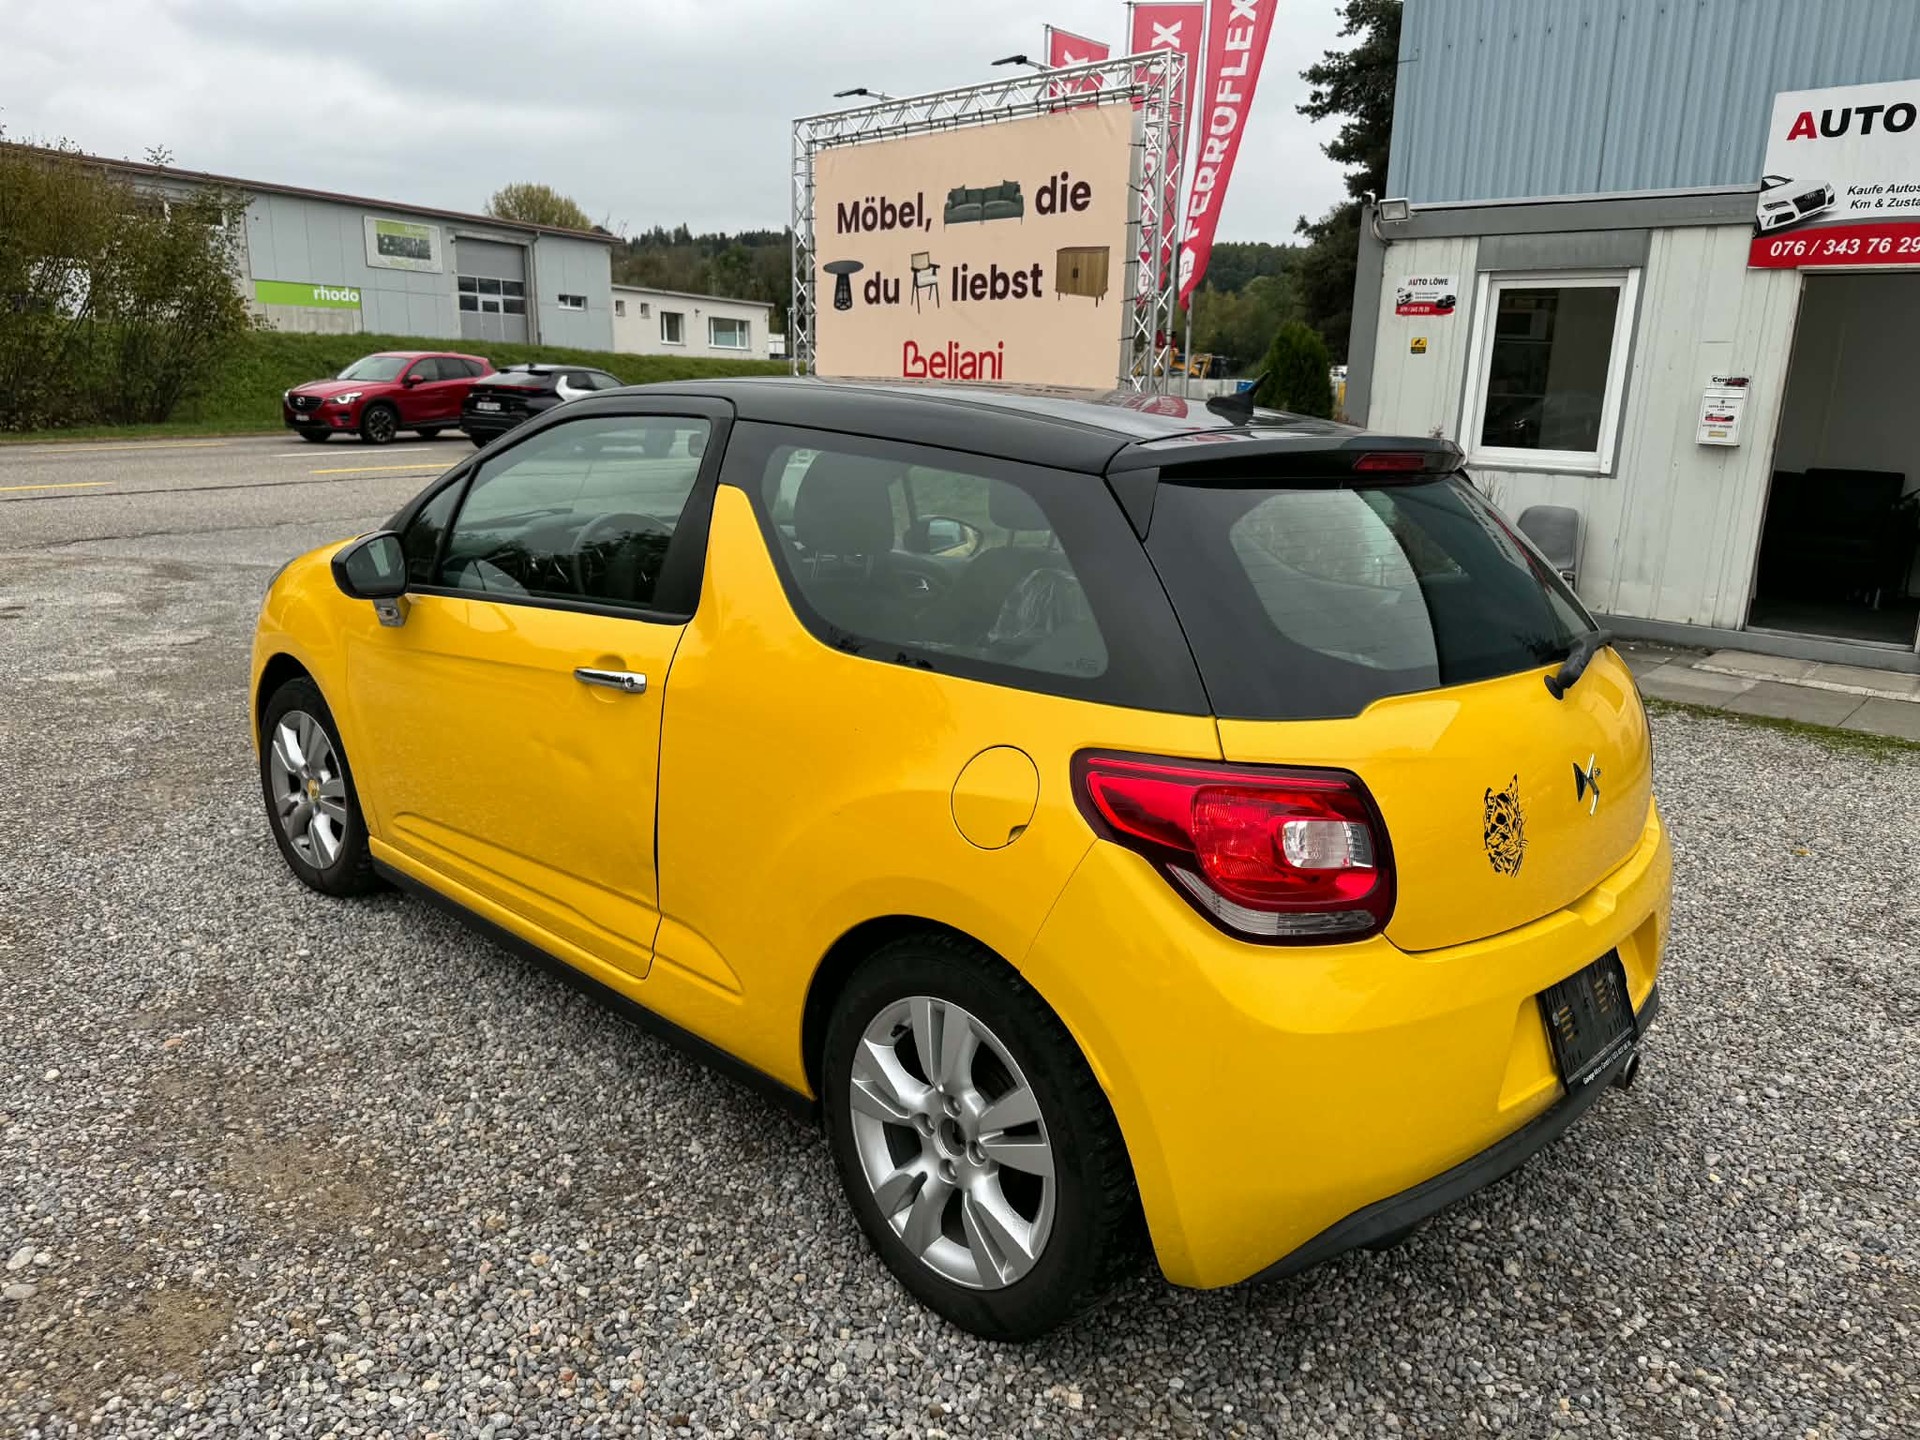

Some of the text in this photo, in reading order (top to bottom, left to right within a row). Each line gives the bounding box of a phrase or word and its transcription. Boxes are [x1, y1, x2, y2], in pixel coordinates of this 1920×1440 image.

[1184, 0, 1259, 242] FERROFLEX
[1786, 102, 1918, 141] AUTO
[837, 171, 1092, 234] Möbel, die
[1847, 184, 1884, 195] Kaufe
[1850, 199, 1871, 210] Km
[1874, 198, 1884, 208] &
[1770, 240, 1807, 256] 076
[1823, 238, 1861, 255] 343
[1866, 237, 1893, 254] 76
[1897, 236, 1920, 253] 29
[313, 286, 360, 303] rhodo
[863, 262, 1043, 305] du liebst
[1408, 278, 1428, 286] AUTO
[903, 340, 1004, 380] Beliani
